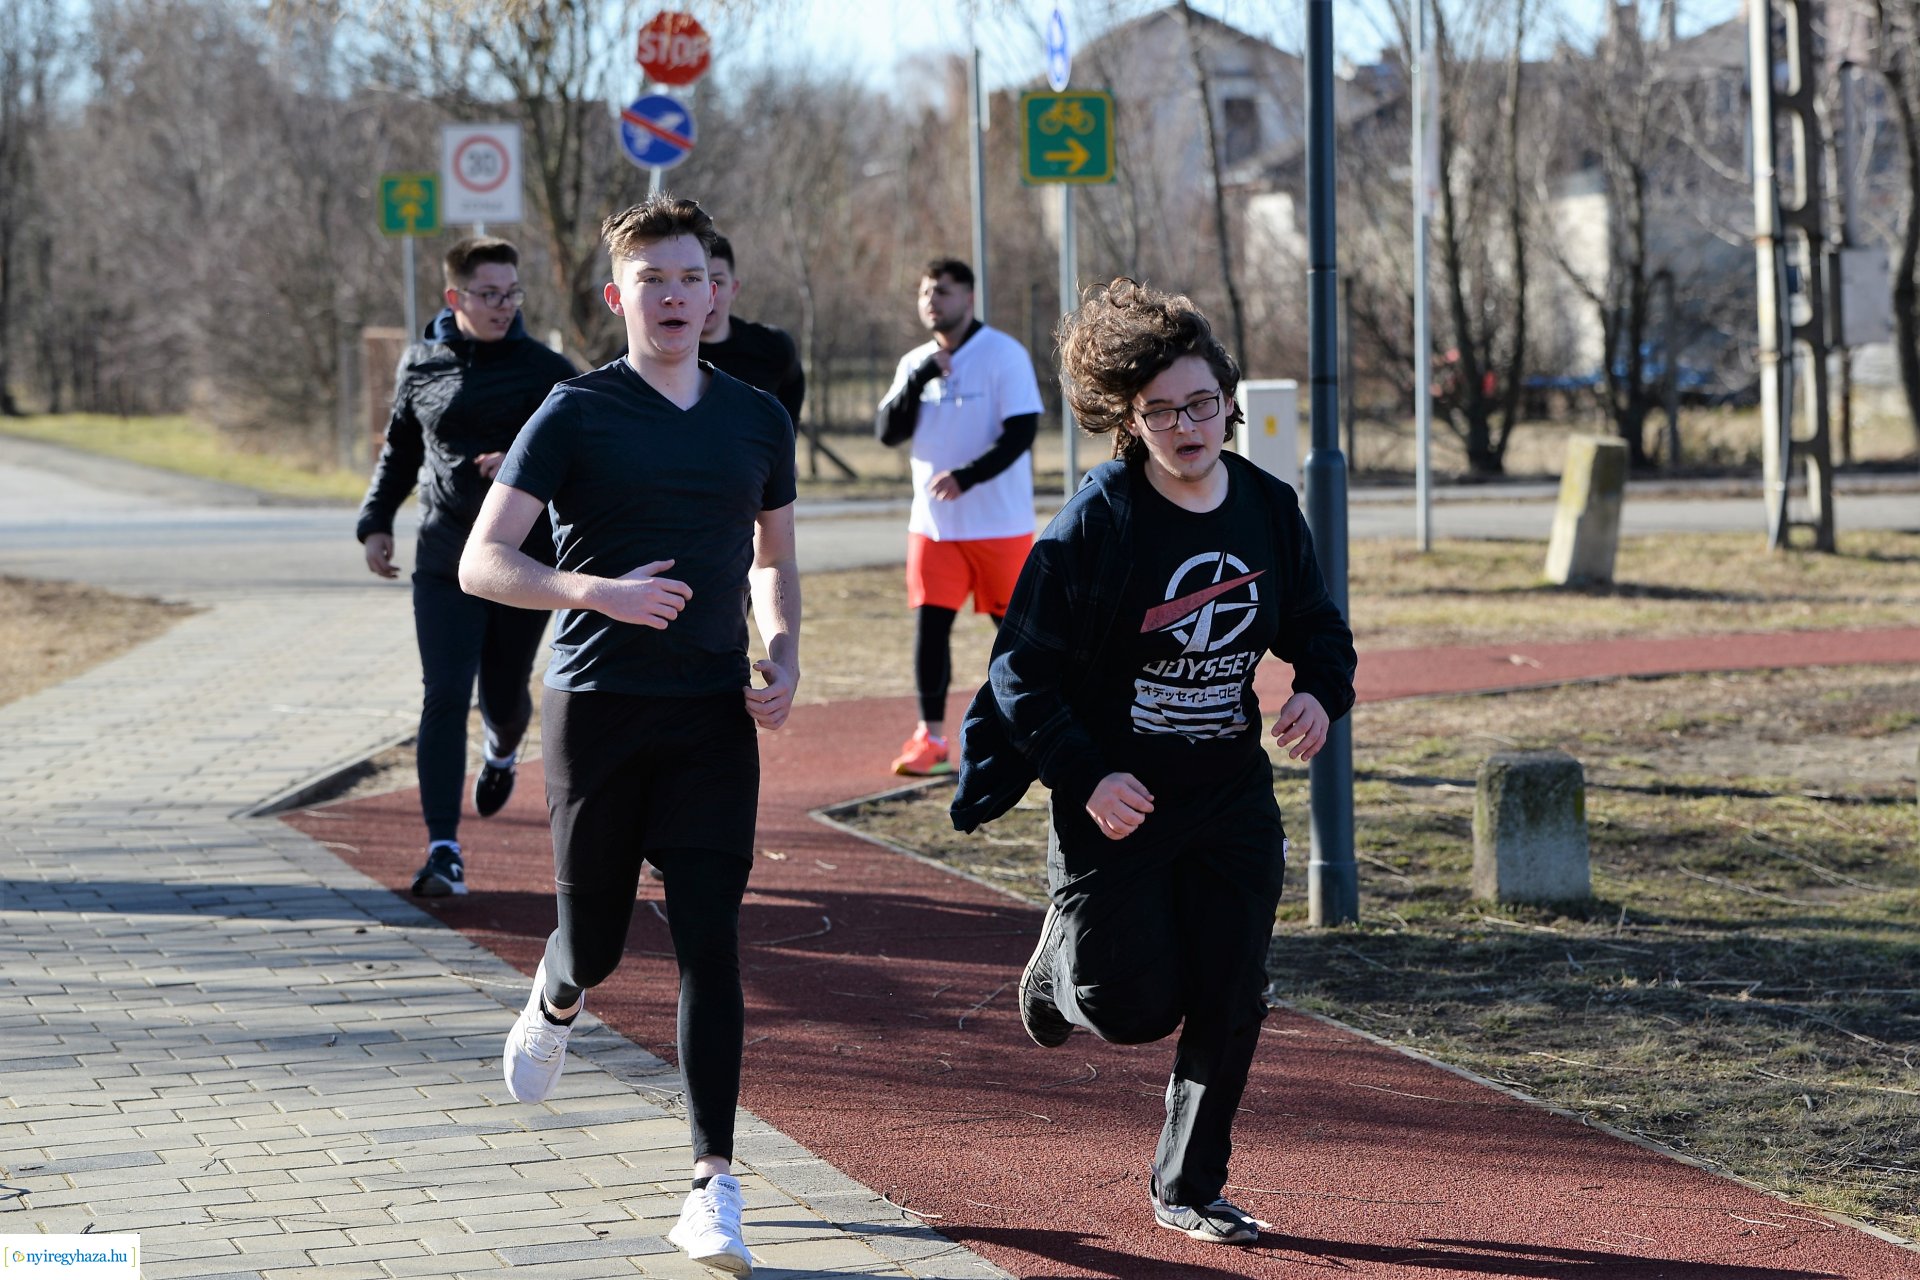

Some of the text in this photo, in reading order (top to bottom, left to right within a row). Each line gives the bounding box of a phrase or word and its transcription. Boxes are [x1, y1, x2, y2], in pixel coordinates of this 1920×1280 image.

[638, 32, 708, 67] STOP
[1142, 651, 1261, 681] ODYSSEY
[1140, 684, 1241, 703] オデッセイユーロビ
